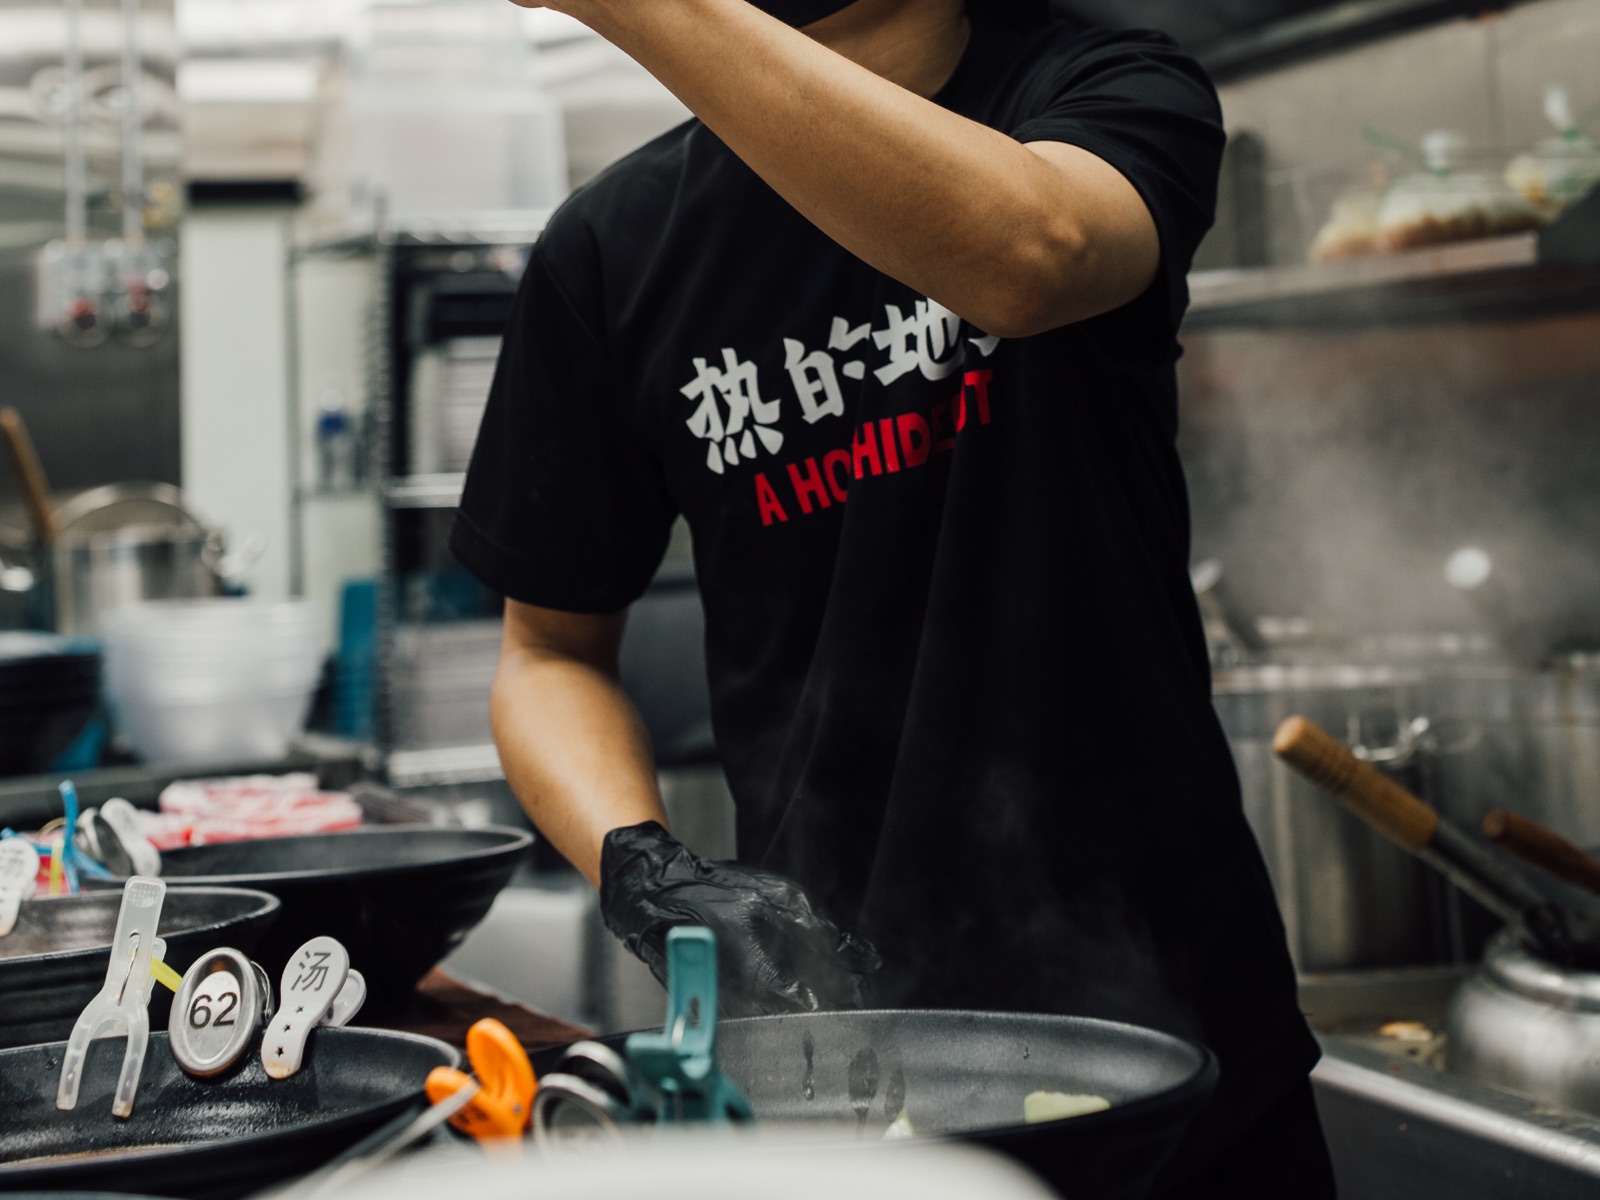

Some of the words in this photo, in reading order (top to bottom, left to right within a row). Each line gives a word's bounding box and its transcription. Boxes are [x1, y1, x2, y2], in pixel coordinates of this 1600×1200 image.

[679, 297, 1000, 474] 热的地
[754, 472, 788, 527] A
[786, 449, 850, 514] HO
[291, 950, 331, 992] 汤
[189, 991, 239, 1029] 62
